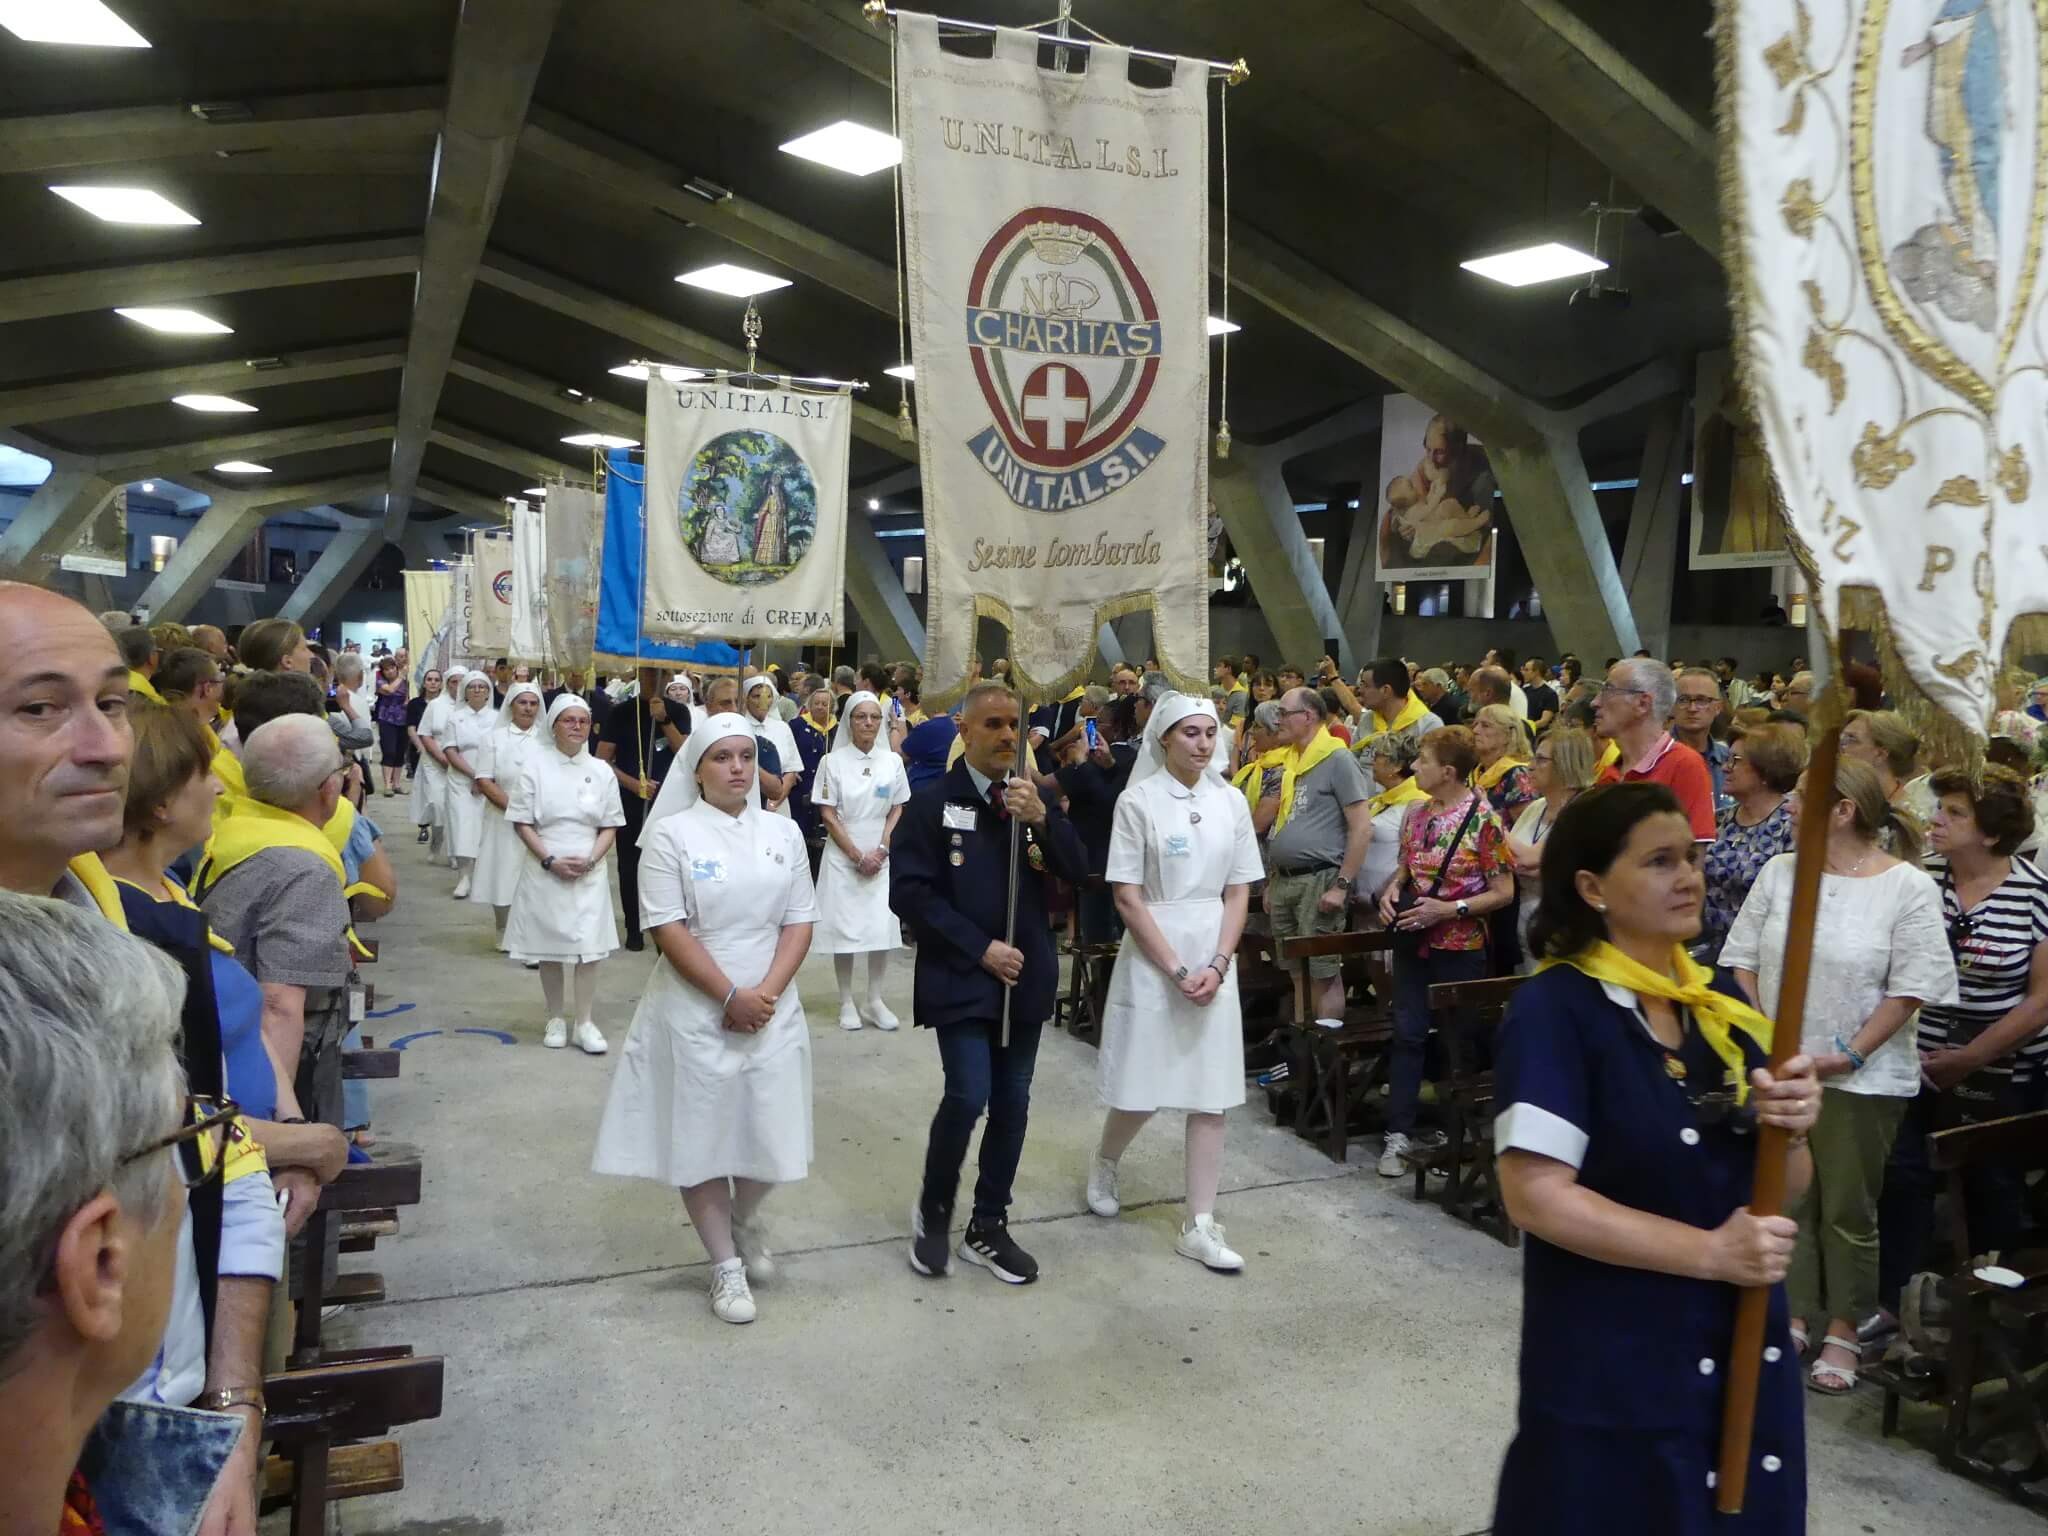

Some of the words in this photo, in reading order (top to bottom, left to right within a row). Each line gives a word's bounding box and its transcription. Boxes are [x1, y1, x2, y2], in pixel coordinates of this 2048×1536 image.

[940, 115, 1178, 178] U.N.I.T.A.L.S.I.
[973, 310, 1154, 357] CHARITAS
[1044, 529, 1161, 568] Lombarda
[656, 608, 734, 624] sottosezione
[742, 605, 754, 625] di
[766, 609, 833, 630] CREMA
